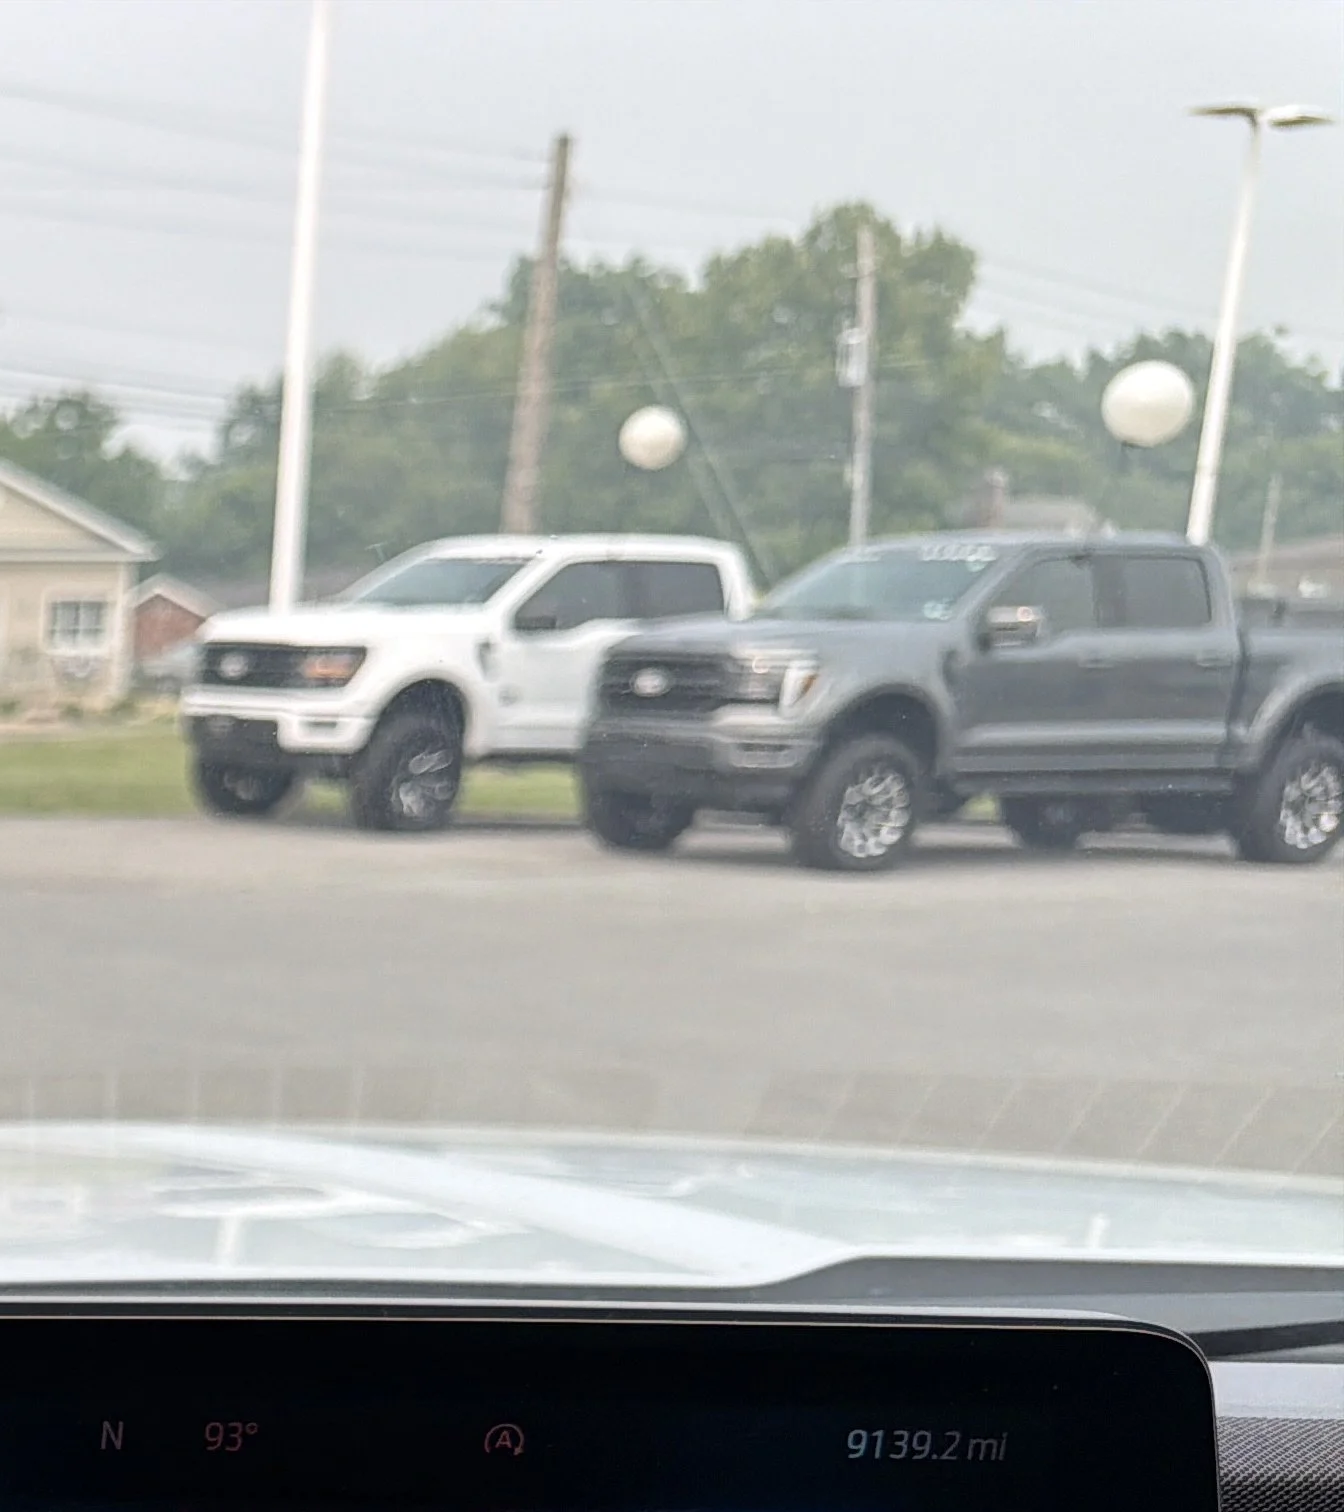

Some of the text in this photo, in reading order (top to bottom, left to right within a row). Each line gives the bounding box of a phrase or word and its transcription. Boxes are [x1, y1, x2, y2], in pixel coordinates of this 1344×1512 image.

[100, 1420, 124, 1451] N
[204, 1421, 259, 1452] 93°
[846, 1429, 1009, 1463] 9139.2 mi
